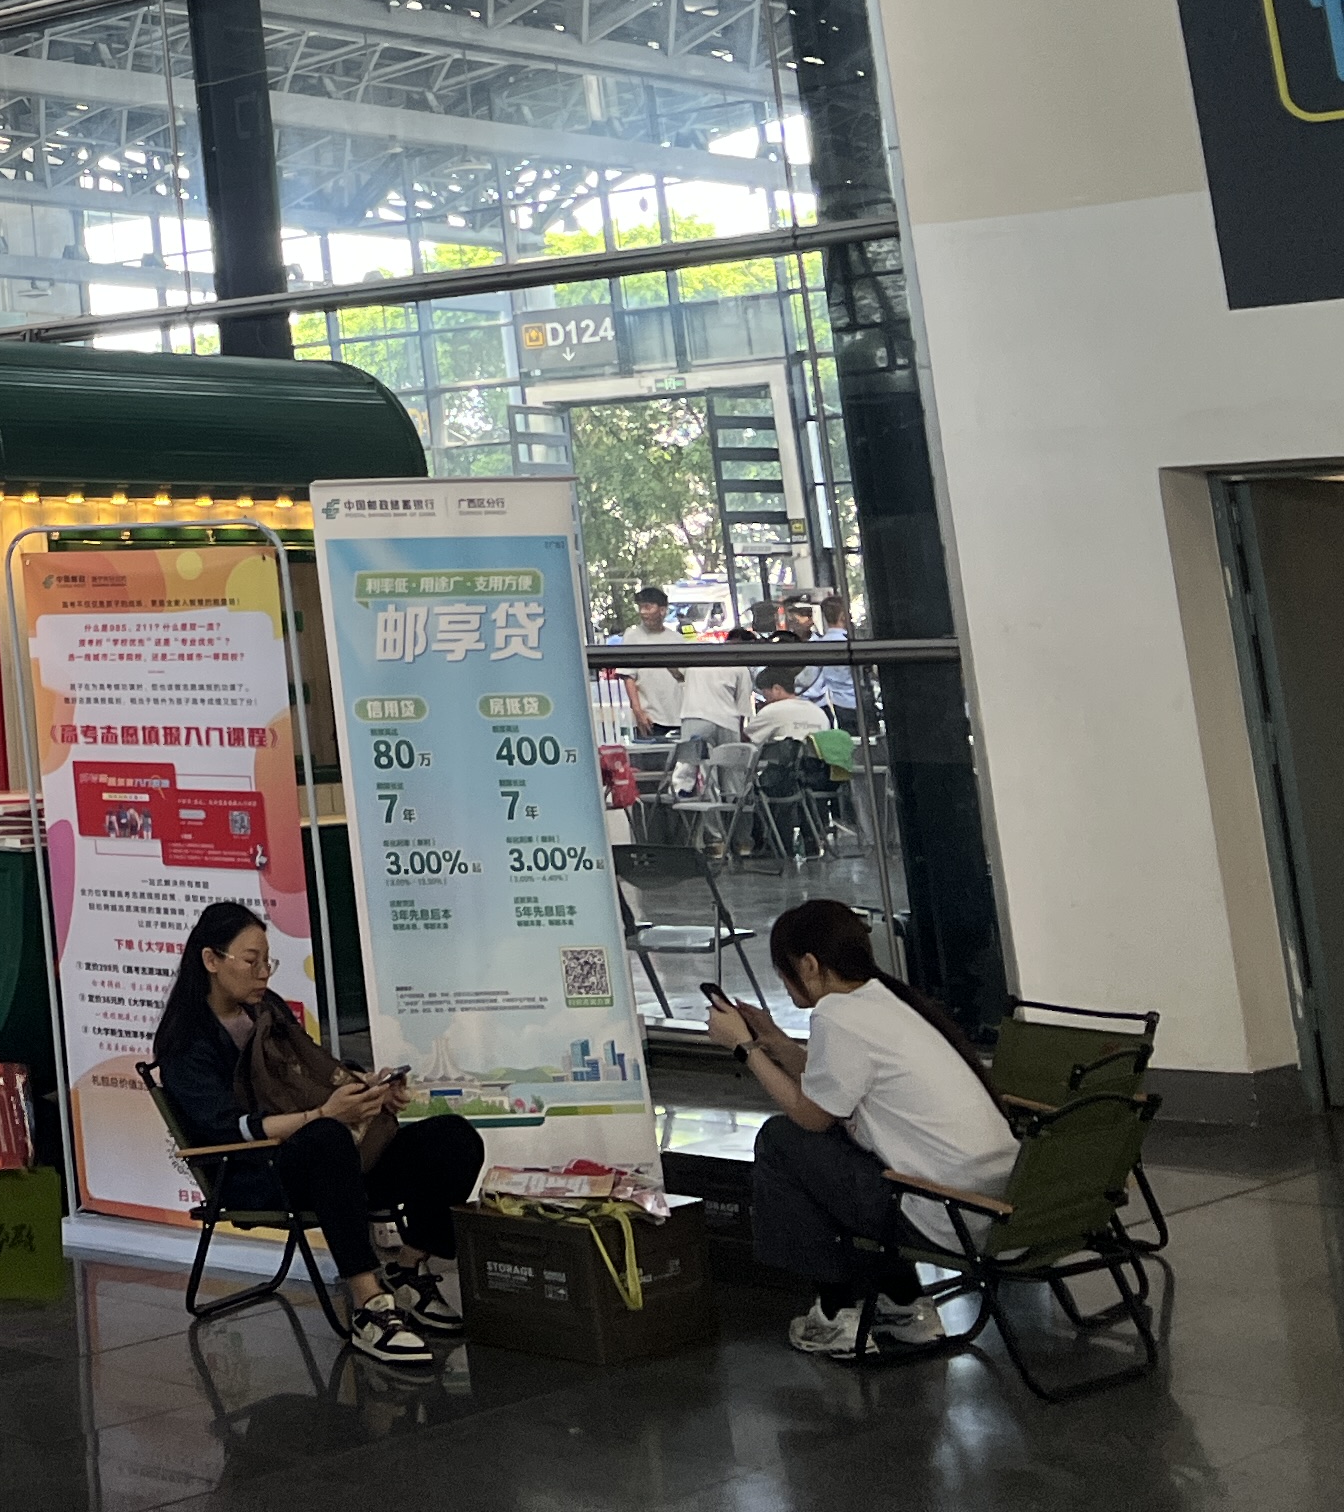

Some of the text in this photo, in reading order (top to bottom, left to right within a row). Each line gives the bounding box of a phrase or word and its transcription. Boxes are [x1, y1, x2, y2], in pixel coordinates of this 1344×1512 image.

[344, 497, 506, 511] 中国邮政储蓄银行 广西区分行
[376, 601, 545, 663] 邮享贷
[366, 699, 417, 719] 信用贷
[489, 697, 541, 716] 房抵贷
[50, 724, 280, 749] 《高考志愿填报入门课程》
